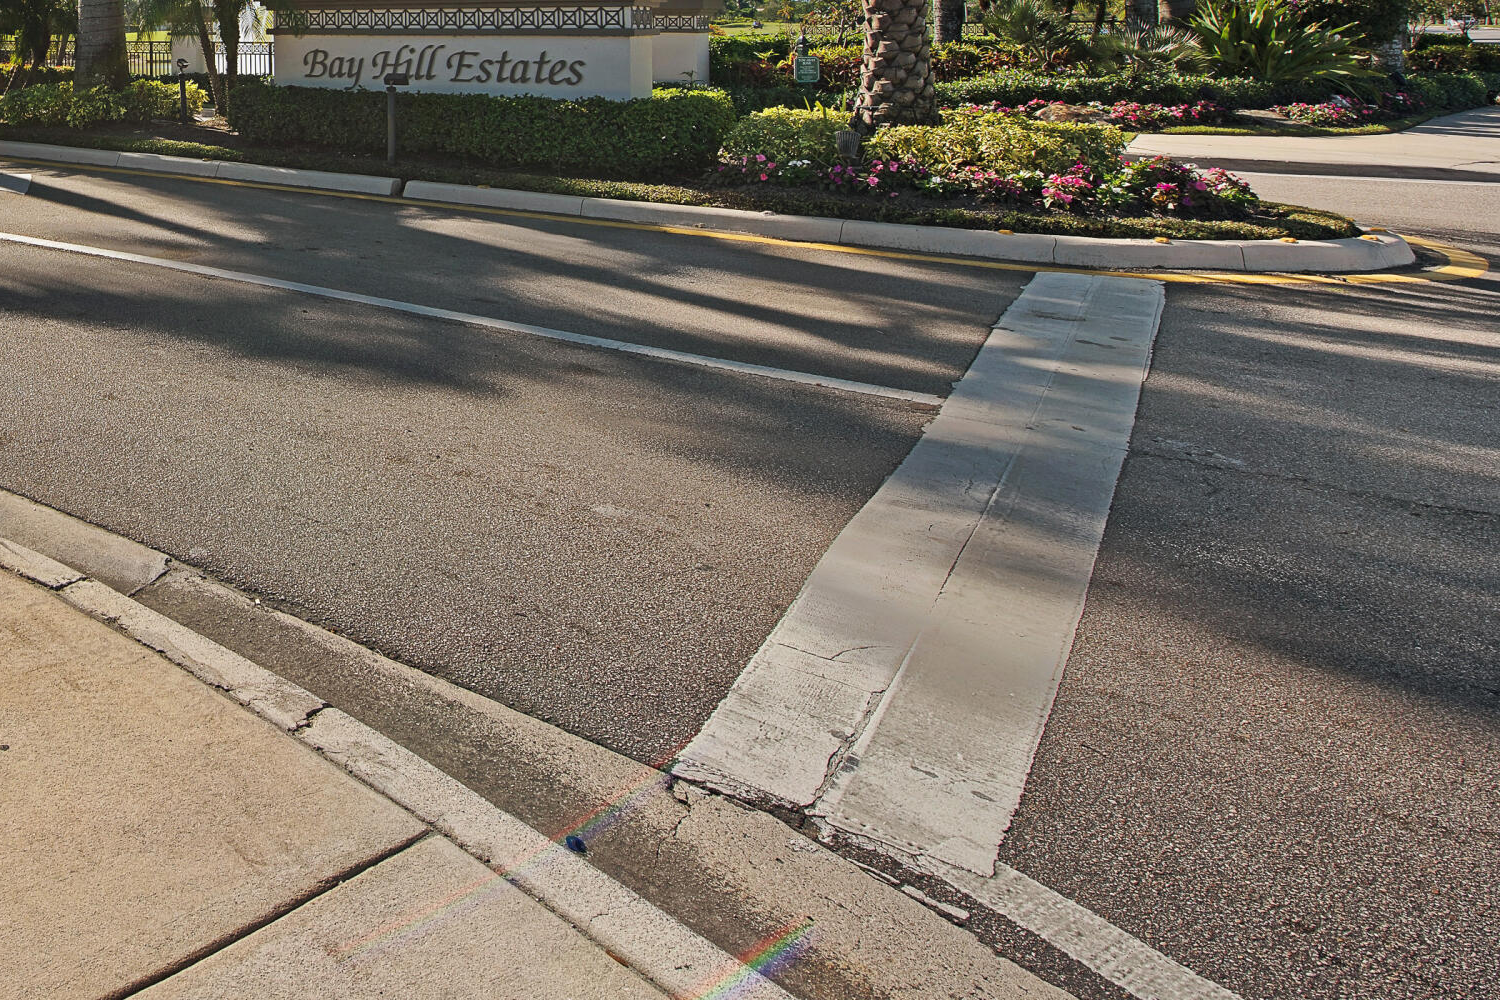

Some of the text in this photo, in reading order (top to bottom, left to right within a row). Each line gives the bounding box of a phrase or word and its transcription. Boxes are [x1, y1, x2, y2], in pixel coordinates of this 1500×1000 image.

[303, 44, 586, 90] Bay Hill Estates
